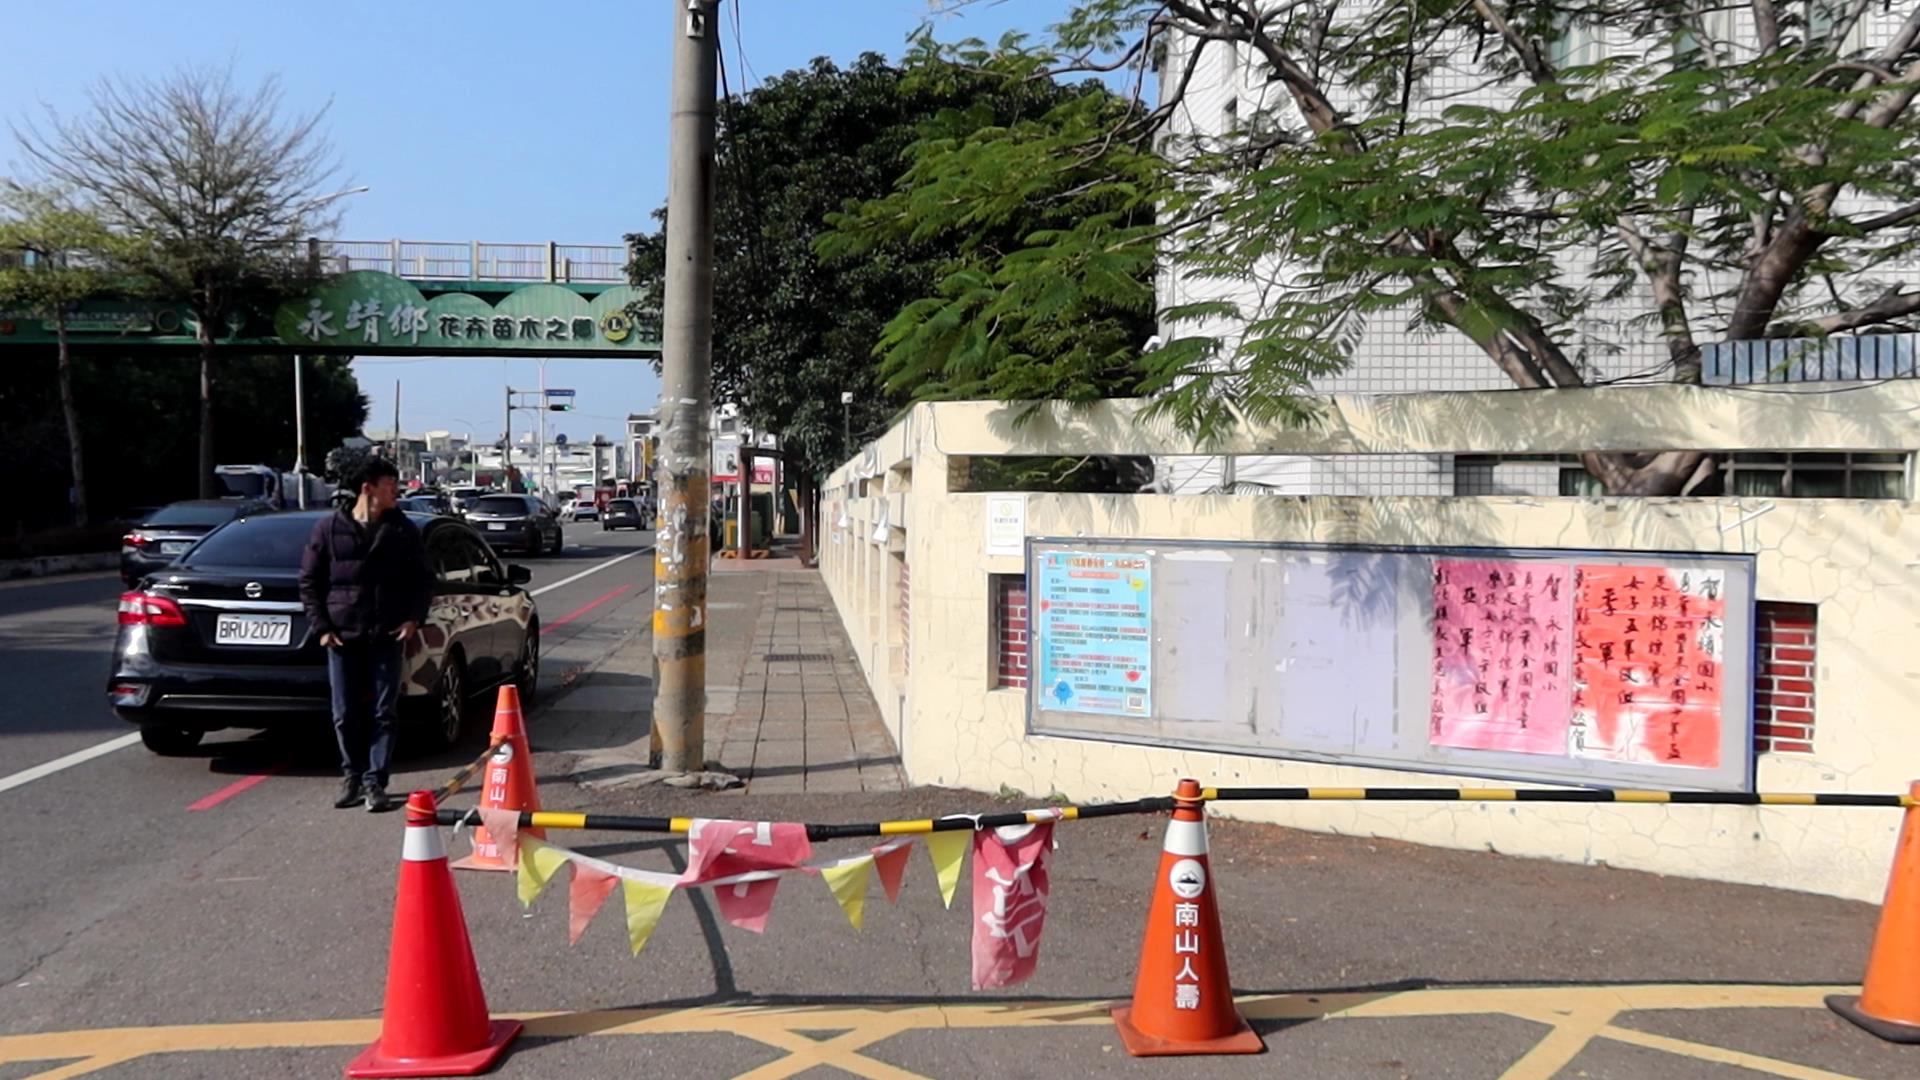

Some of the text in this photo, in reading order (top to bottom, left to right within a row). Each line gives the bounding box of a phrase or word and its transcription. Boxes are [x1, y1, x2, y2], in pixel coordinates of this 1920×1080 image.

[297, 298, 428, 345] 永靖鄉
[1175, 902, 1200, 1008] 南山人壽
